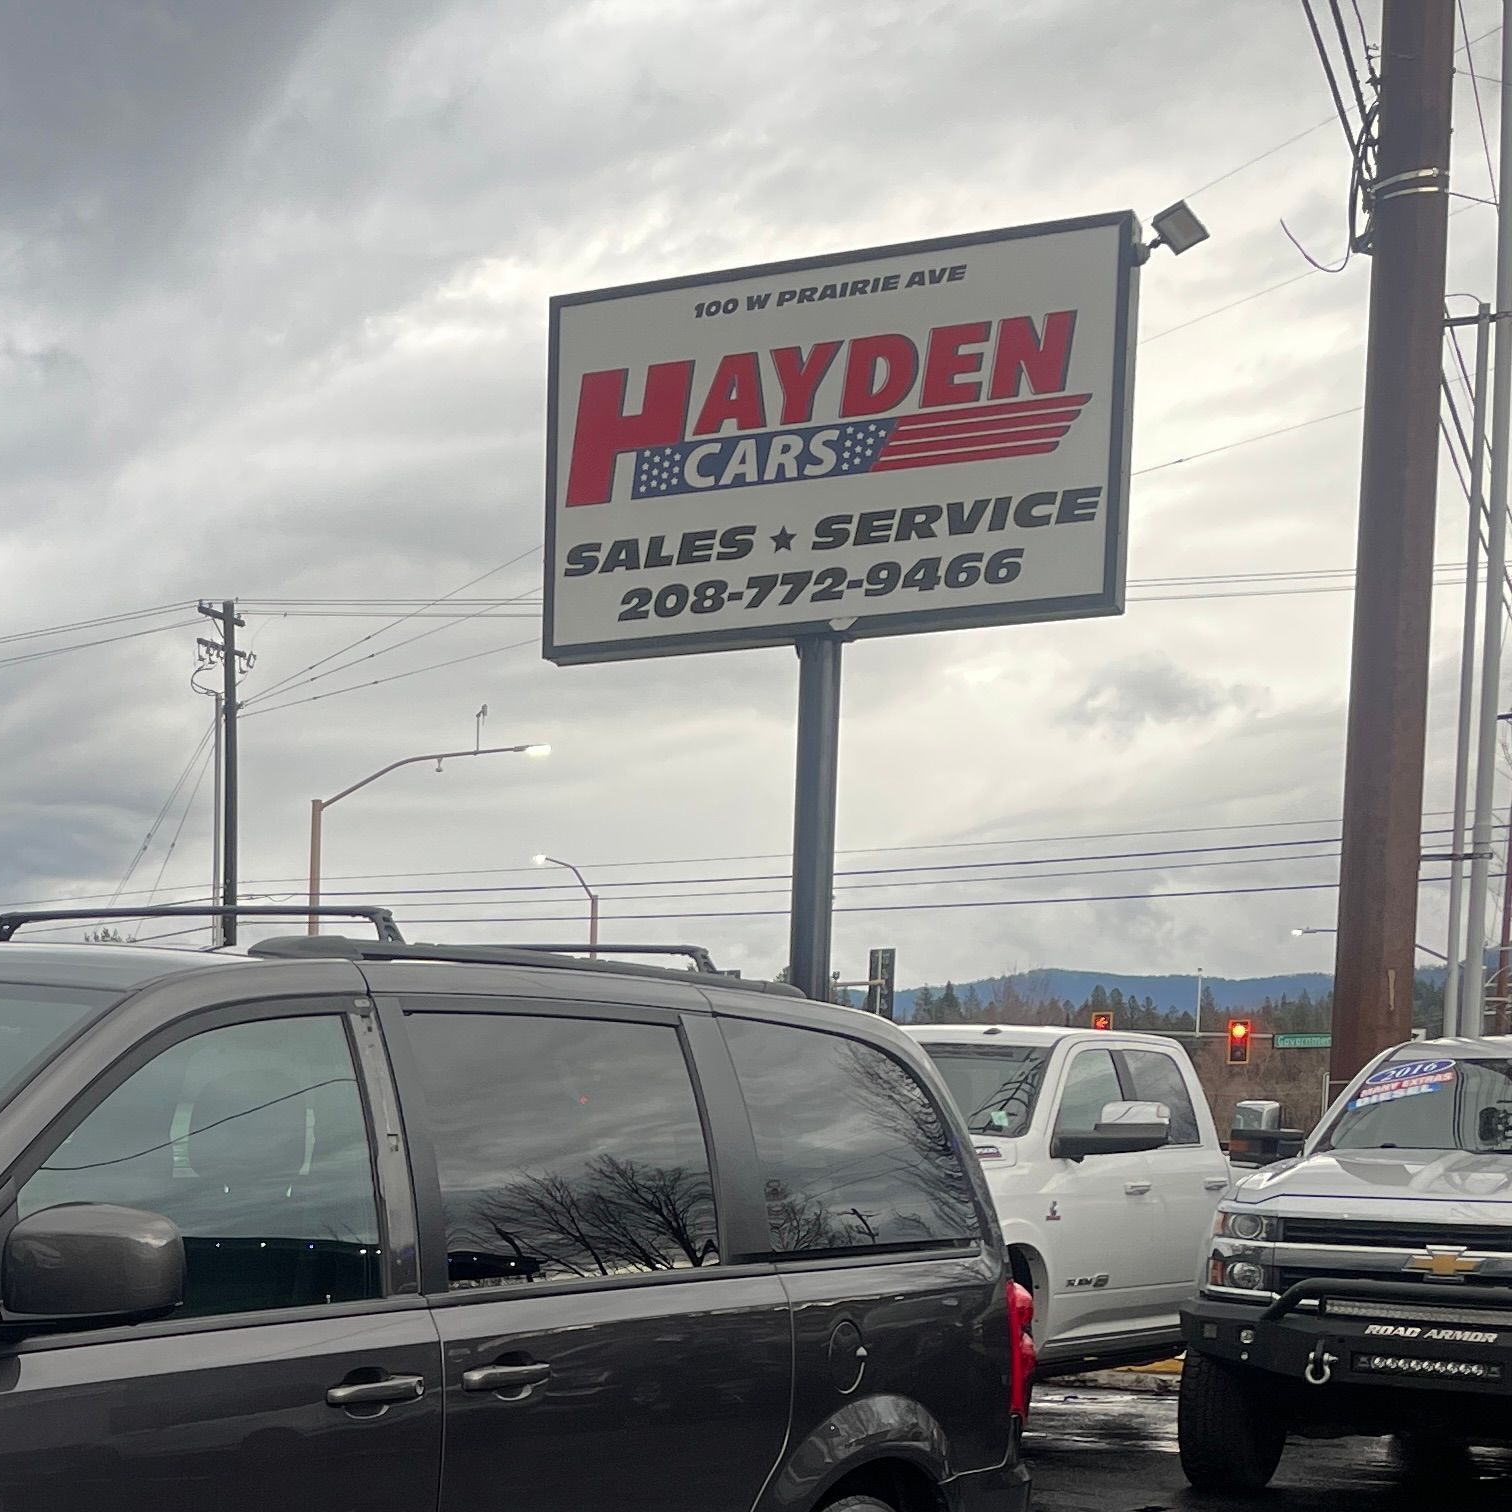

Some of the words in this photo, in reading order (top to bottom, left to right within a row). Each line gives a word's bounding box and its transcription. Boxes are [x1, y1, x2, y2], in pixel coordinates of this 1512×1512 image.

[694, 298, 738, 318] 100
[746, 293, 773, 311] W
[776, 274, 901, 307] PRAIRIE
[904, 264, 967, 288] AVE
[565, 309, 1078, 508] HAYDEN
[684, 429, 840, 488] CARS
[564, 525, 757, 577] SALES
[811, 486, 1103, 551] SERVICE
[617, 548, 1025, 622] 208-772-9466
[1355, 1084, 1434, 1107] DIESEL
[1360, 1081, 1400, 1098] MANY
[1402, 1072, 1454, 1088] EXTRAS
[1381, 1062, 1438, 1082] 2016
[1364, 1324, 1423, 1338] ROAD
[1423, 1328, 1499, 1343] ARMOR
